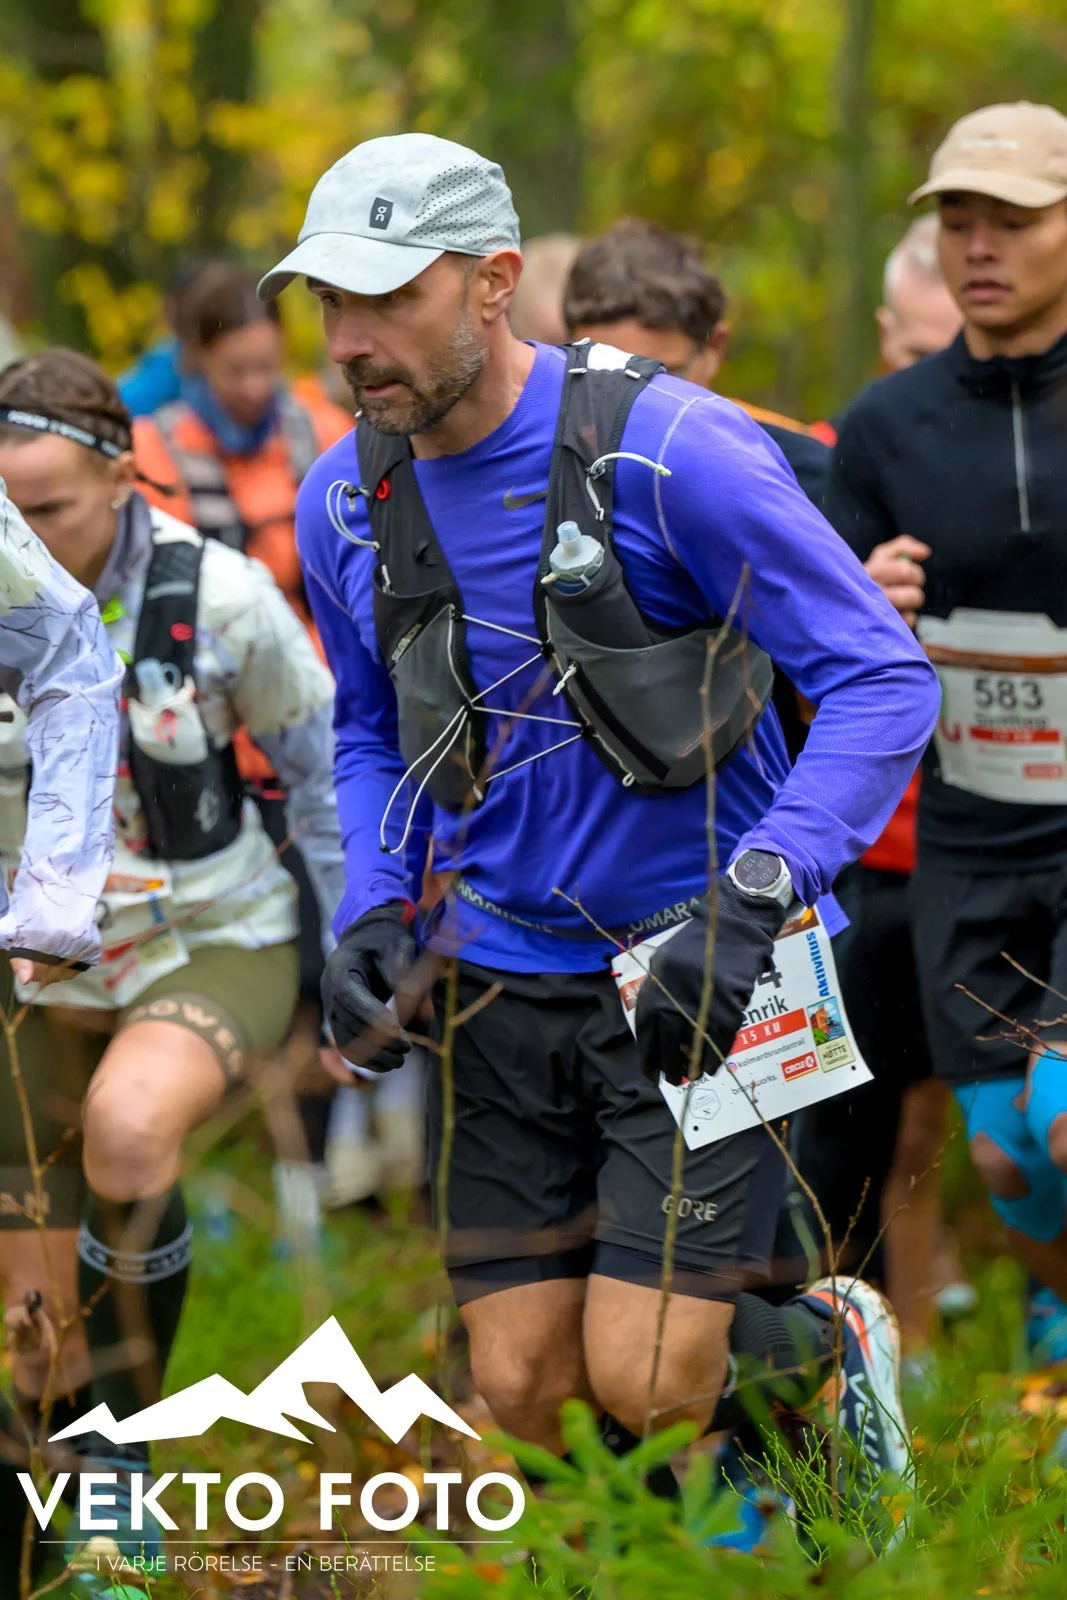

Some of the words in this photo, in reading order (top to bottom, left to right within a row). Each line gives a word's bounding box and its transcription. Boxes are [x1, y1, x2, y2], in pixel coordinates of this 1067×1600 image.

[974, 677, 1045, 711] 583
[741, 1030, 758, 1045] 15
[661, 1194, 718, 1221] GORE
